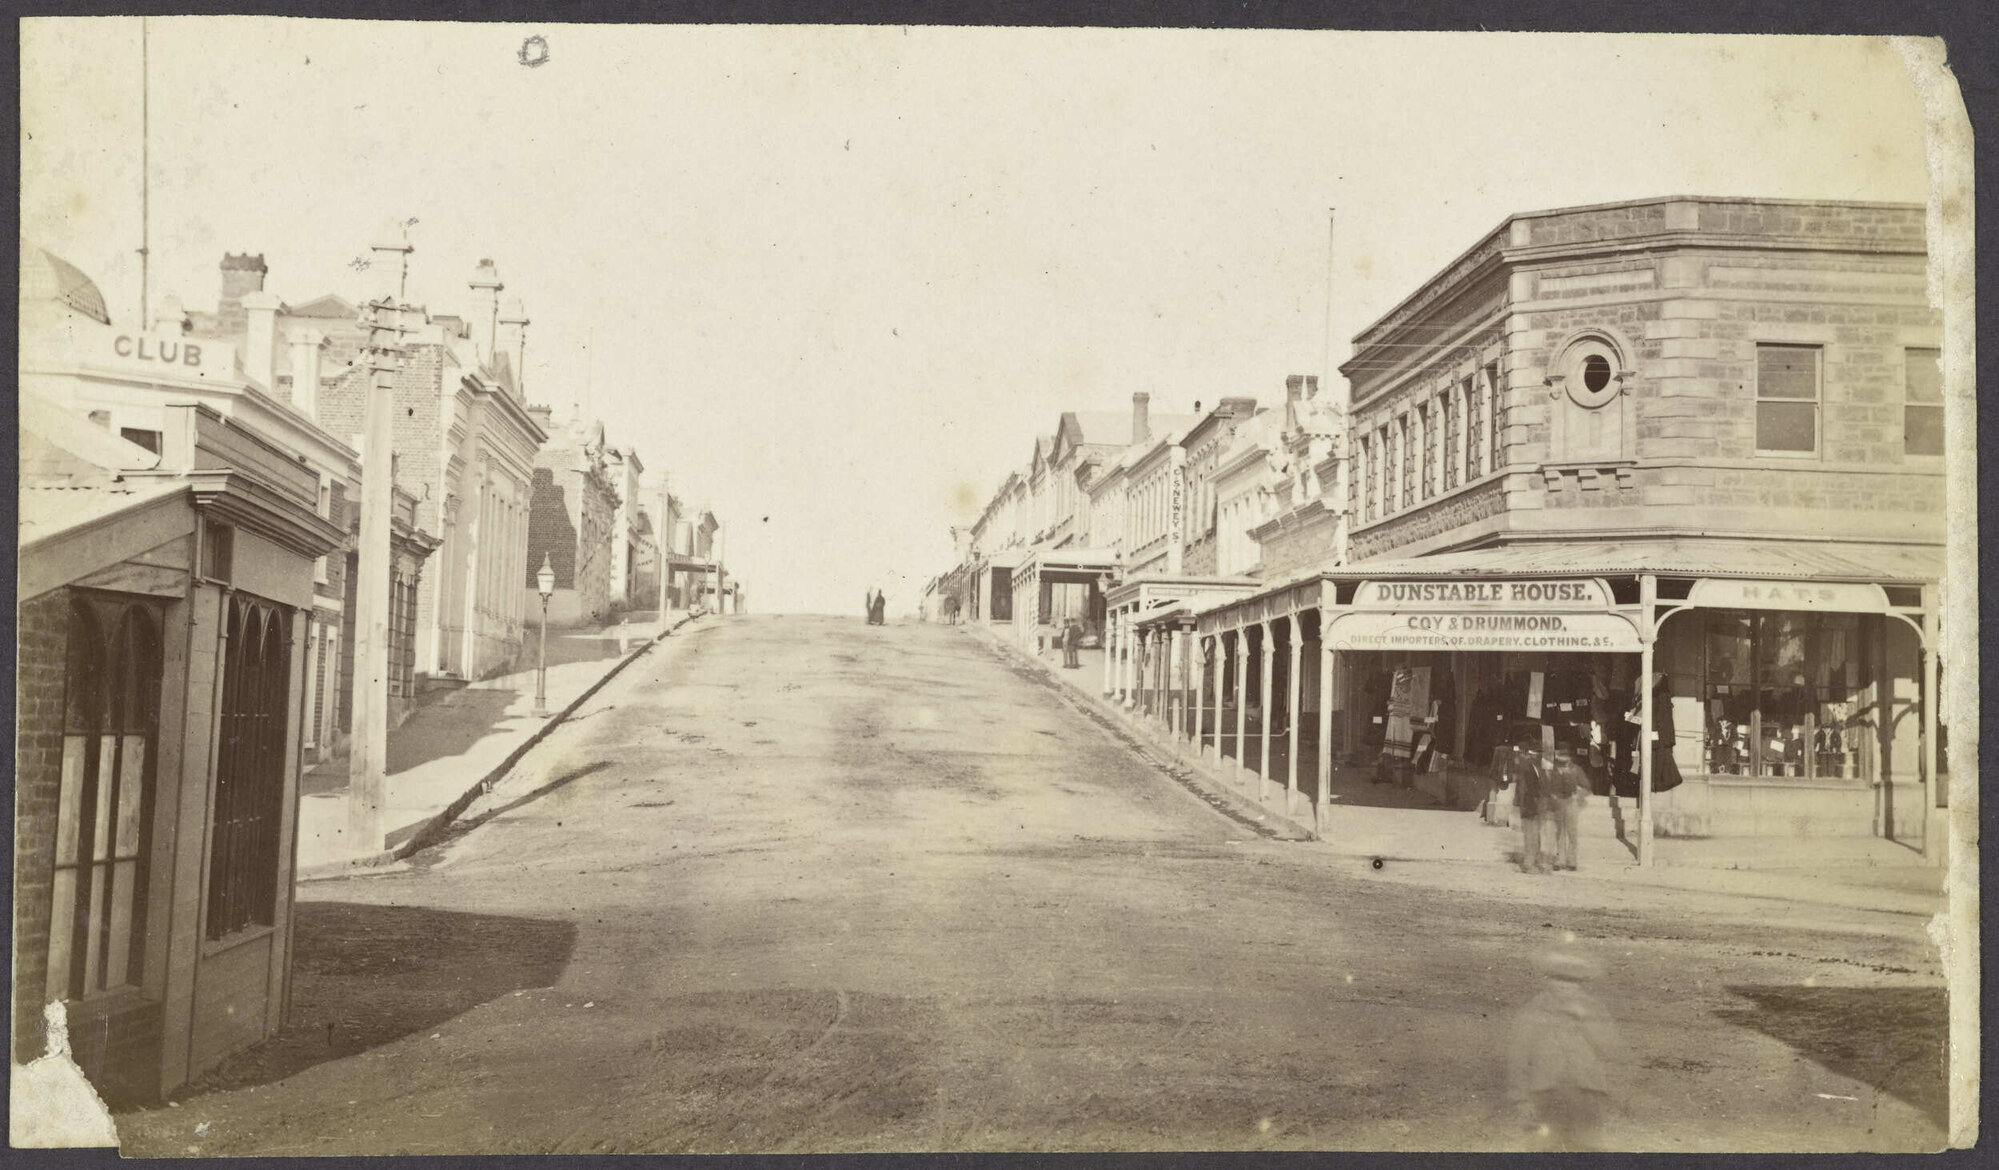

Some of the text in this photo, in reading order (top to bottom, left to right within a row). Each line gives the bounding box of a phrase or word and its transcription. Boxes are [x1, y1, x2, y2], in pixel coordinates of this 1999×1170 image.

[114, 335, 202, 367] CLUB
[1377, 583, 1503, 601] DUNSTABLE
[1743, 586, 1836, 601] HATS
[1408, 615, 1443, 630] COY
[1448, 616, 1459, 630] &
[1350, 634, 1387, 645] DIRECT
